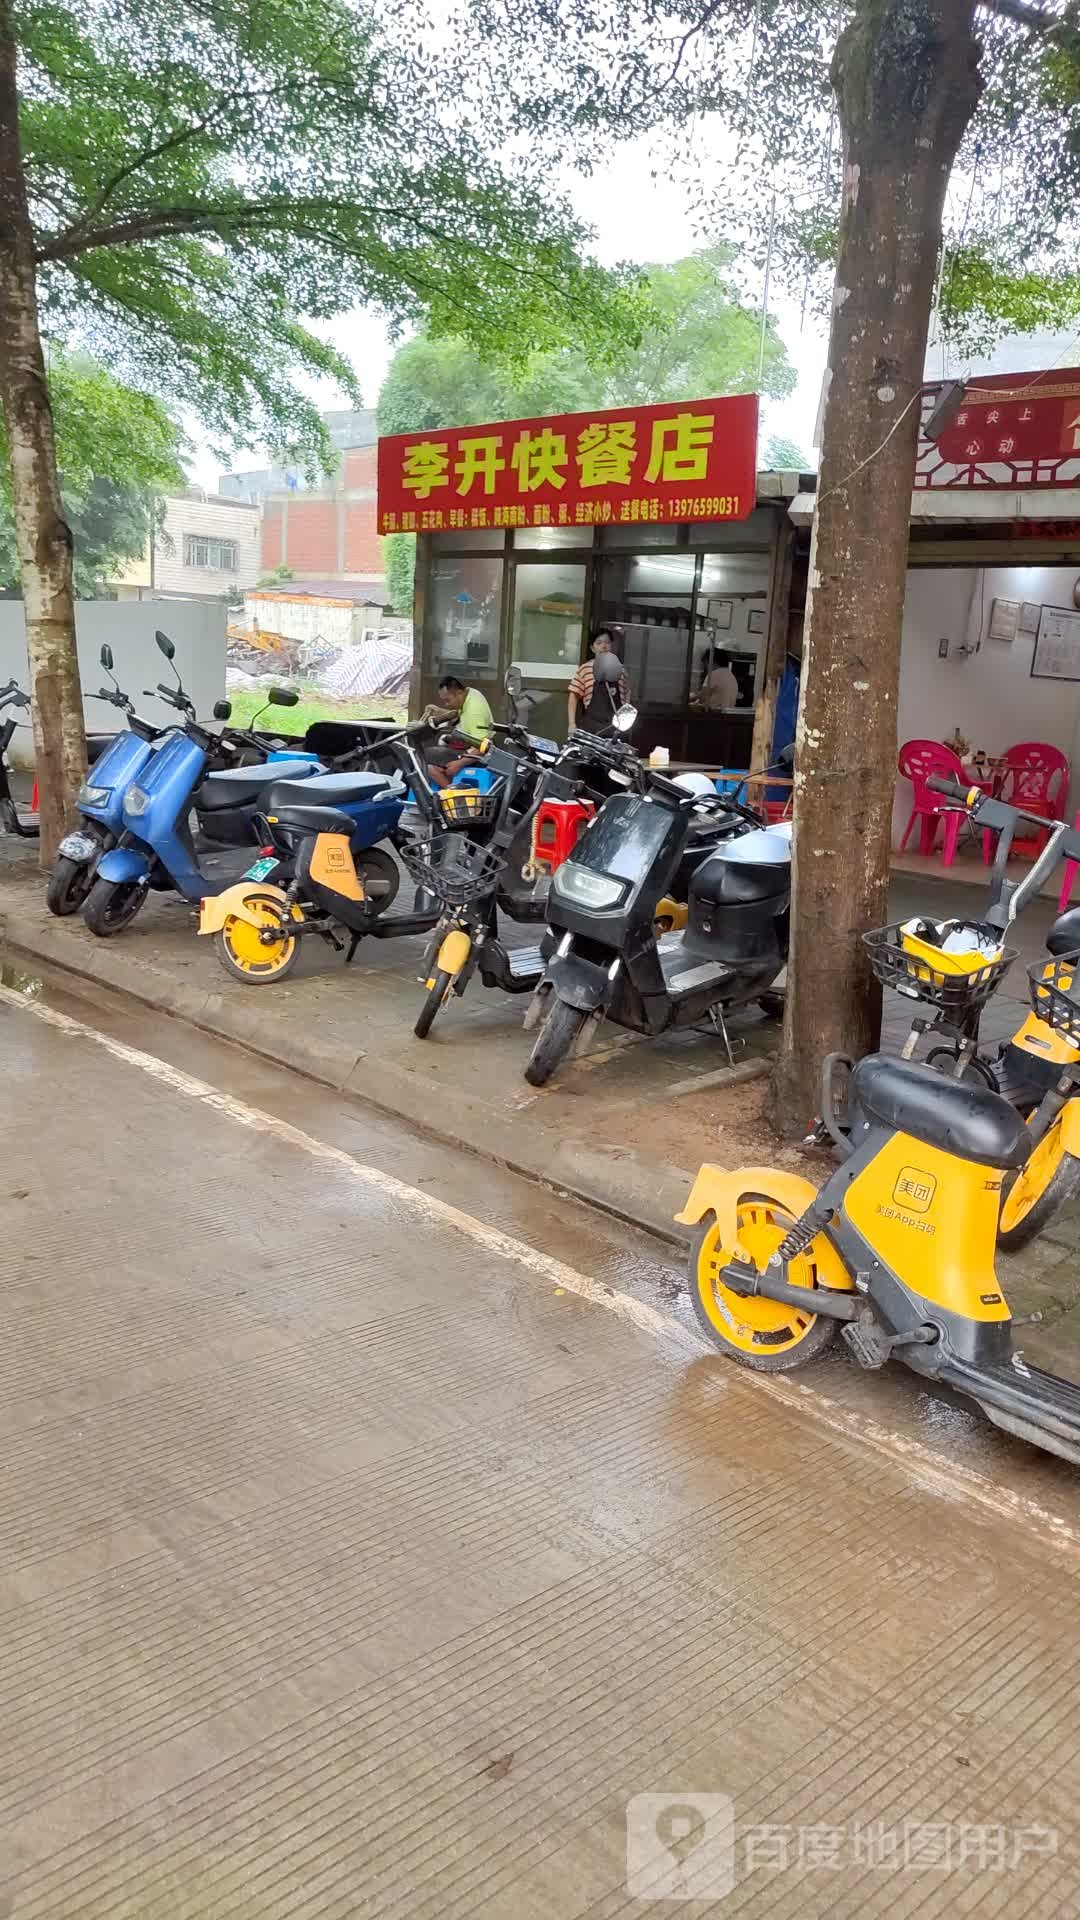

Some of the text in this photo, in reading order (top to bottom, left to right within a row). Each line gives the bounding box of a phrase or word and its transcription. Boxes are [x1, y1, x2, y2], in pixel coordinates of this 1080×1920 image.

[956, 407, 1032, 426] 舌尖上
[402, 414, 715, 498] 李开快餐店
[966, 437, 1014, 455] 心动
[899, 1179, 930, 1200] 美团
